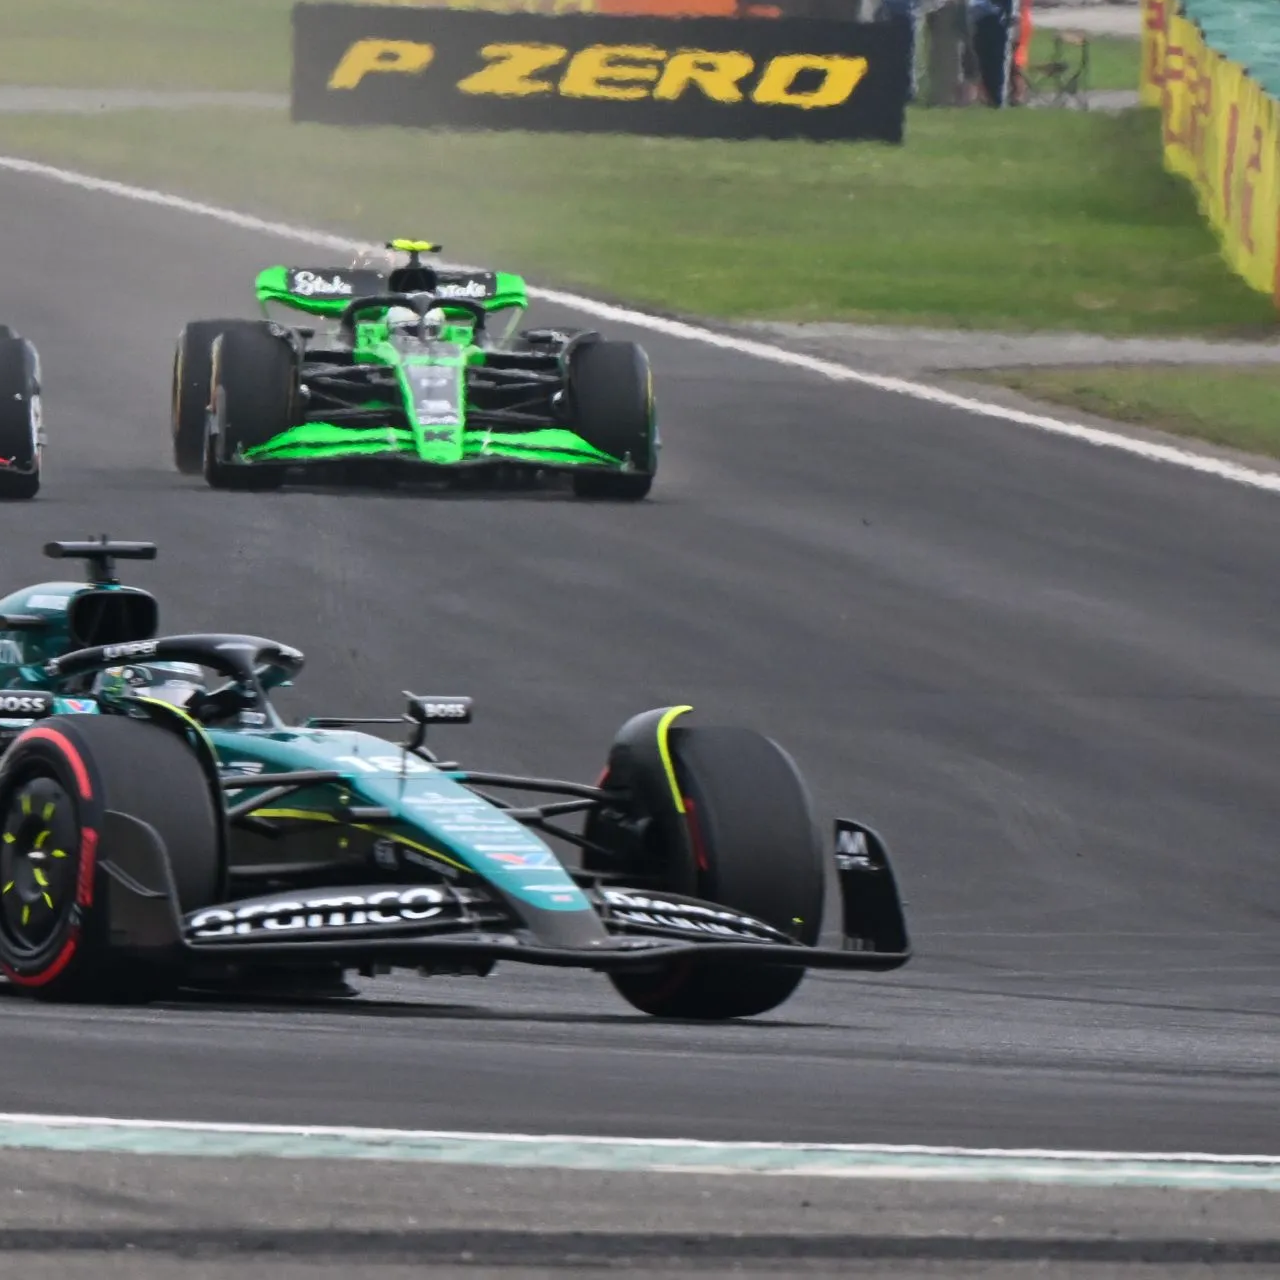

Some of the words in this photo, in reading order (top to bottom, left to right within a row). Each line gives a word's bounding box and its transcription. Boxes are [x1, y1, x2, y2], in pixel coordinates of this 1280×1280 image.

[326, 38, 436, 91] P
[455, 43, 869, 110] ZERO
[424, 703, 466, 718] BOSS
[191, 888, 443, 937] aramco
